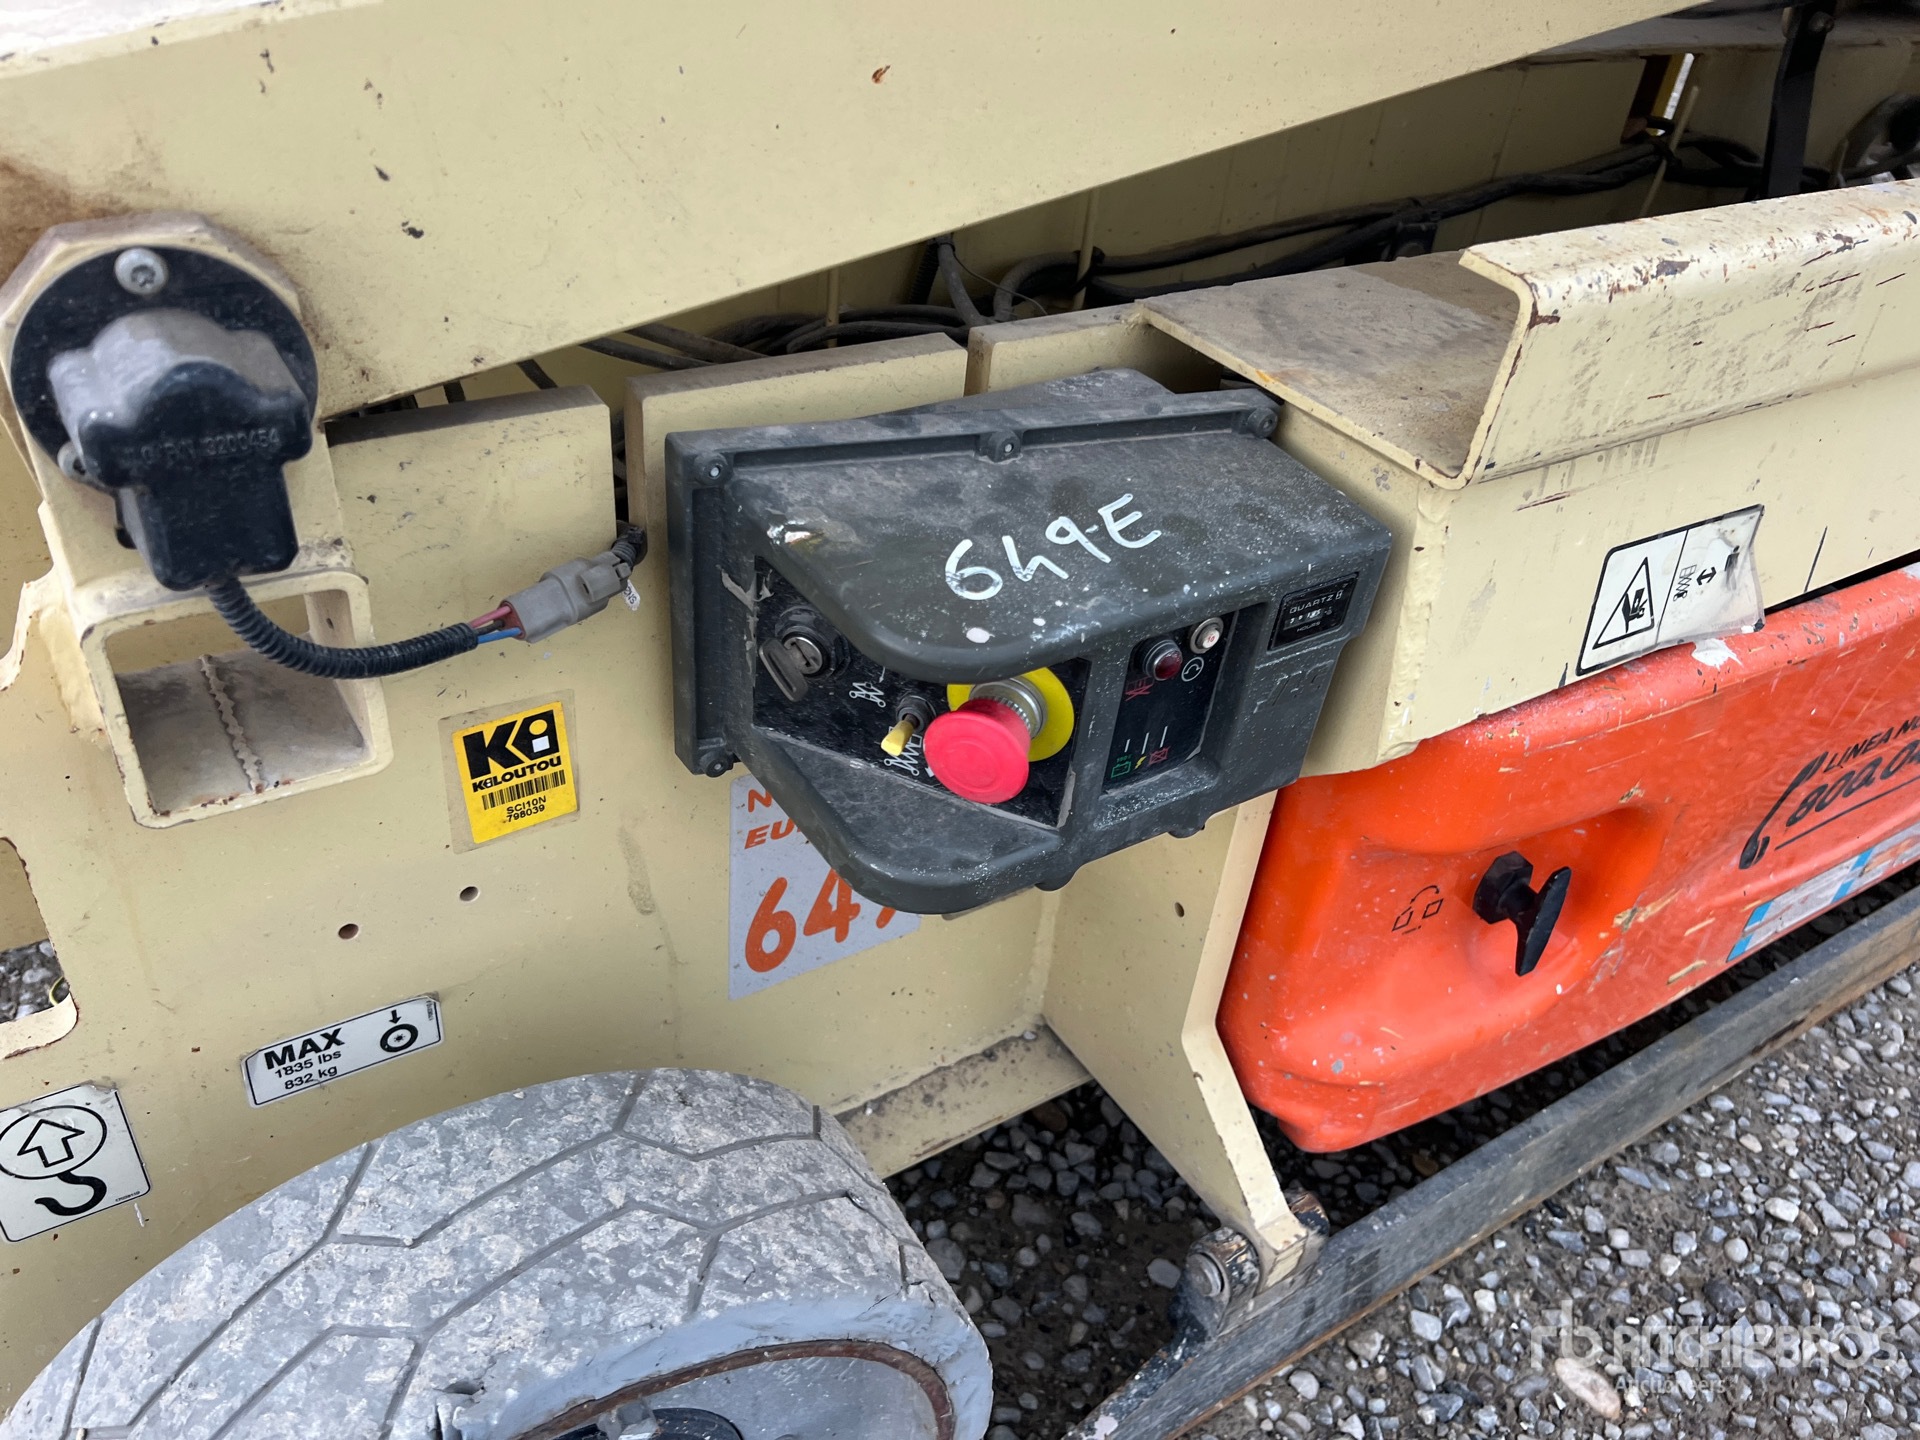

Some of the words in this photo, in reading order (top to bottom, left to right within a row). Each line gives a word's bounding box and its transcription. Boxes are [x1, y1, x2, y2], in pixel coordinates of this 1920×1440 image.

[1289, 594, 1334, 614] QUARTZ
[1823, 726, 1894, 773] LINEA
[506, 804, 545, 823] 798039
[745, 867, 896, 973] 64
[263, 1027, 345, 1070] MAX
[274, 1058, 314, 1079] 1835
[318, 1050, 342, 1065] lbs
[284, 1073, 314, 1090] 832
[318, 1066, 338, 1080] kg
